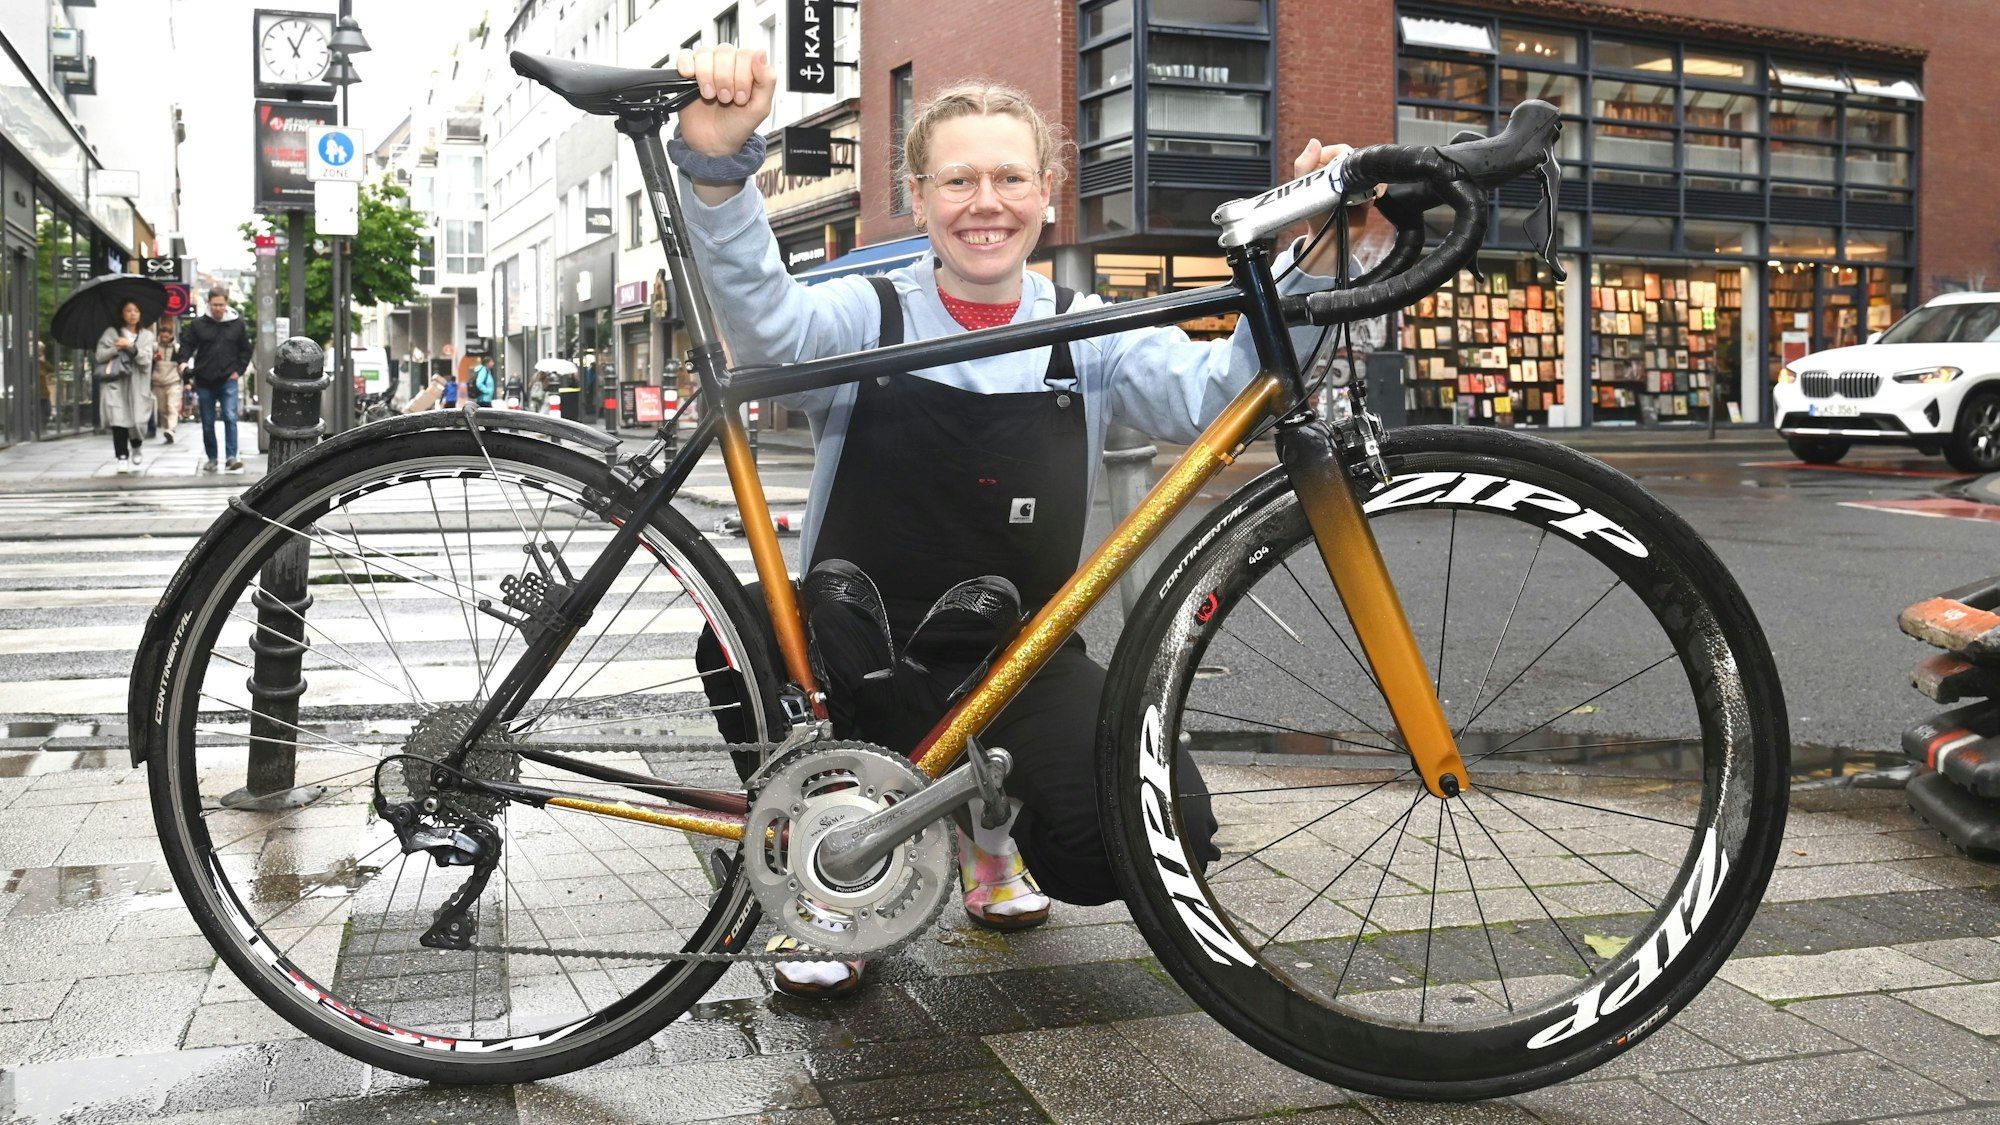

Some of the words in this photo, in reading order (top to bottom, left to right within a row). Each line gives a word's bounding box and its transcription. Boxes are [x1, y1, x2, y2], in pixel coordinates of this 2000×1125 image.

[322, 168, 349, 178] ZONE
[1253, 170, 1325, 210] ZIPP
[1362, 473, 1649, 558] ZIPP
[1159, 504, 1249, 600] CONTINENTAL
[1248, 545, 1270, 565] 404
[154, 610, 193, 726] CONTINENTAL
[1139, 704, 1258, 968] ZIPP
[835, 880, 876, 893] POWERMETER
[1527, 827, 1729, 1050] ZIPP
[1627, 1004, 1669, 1043] 5000
